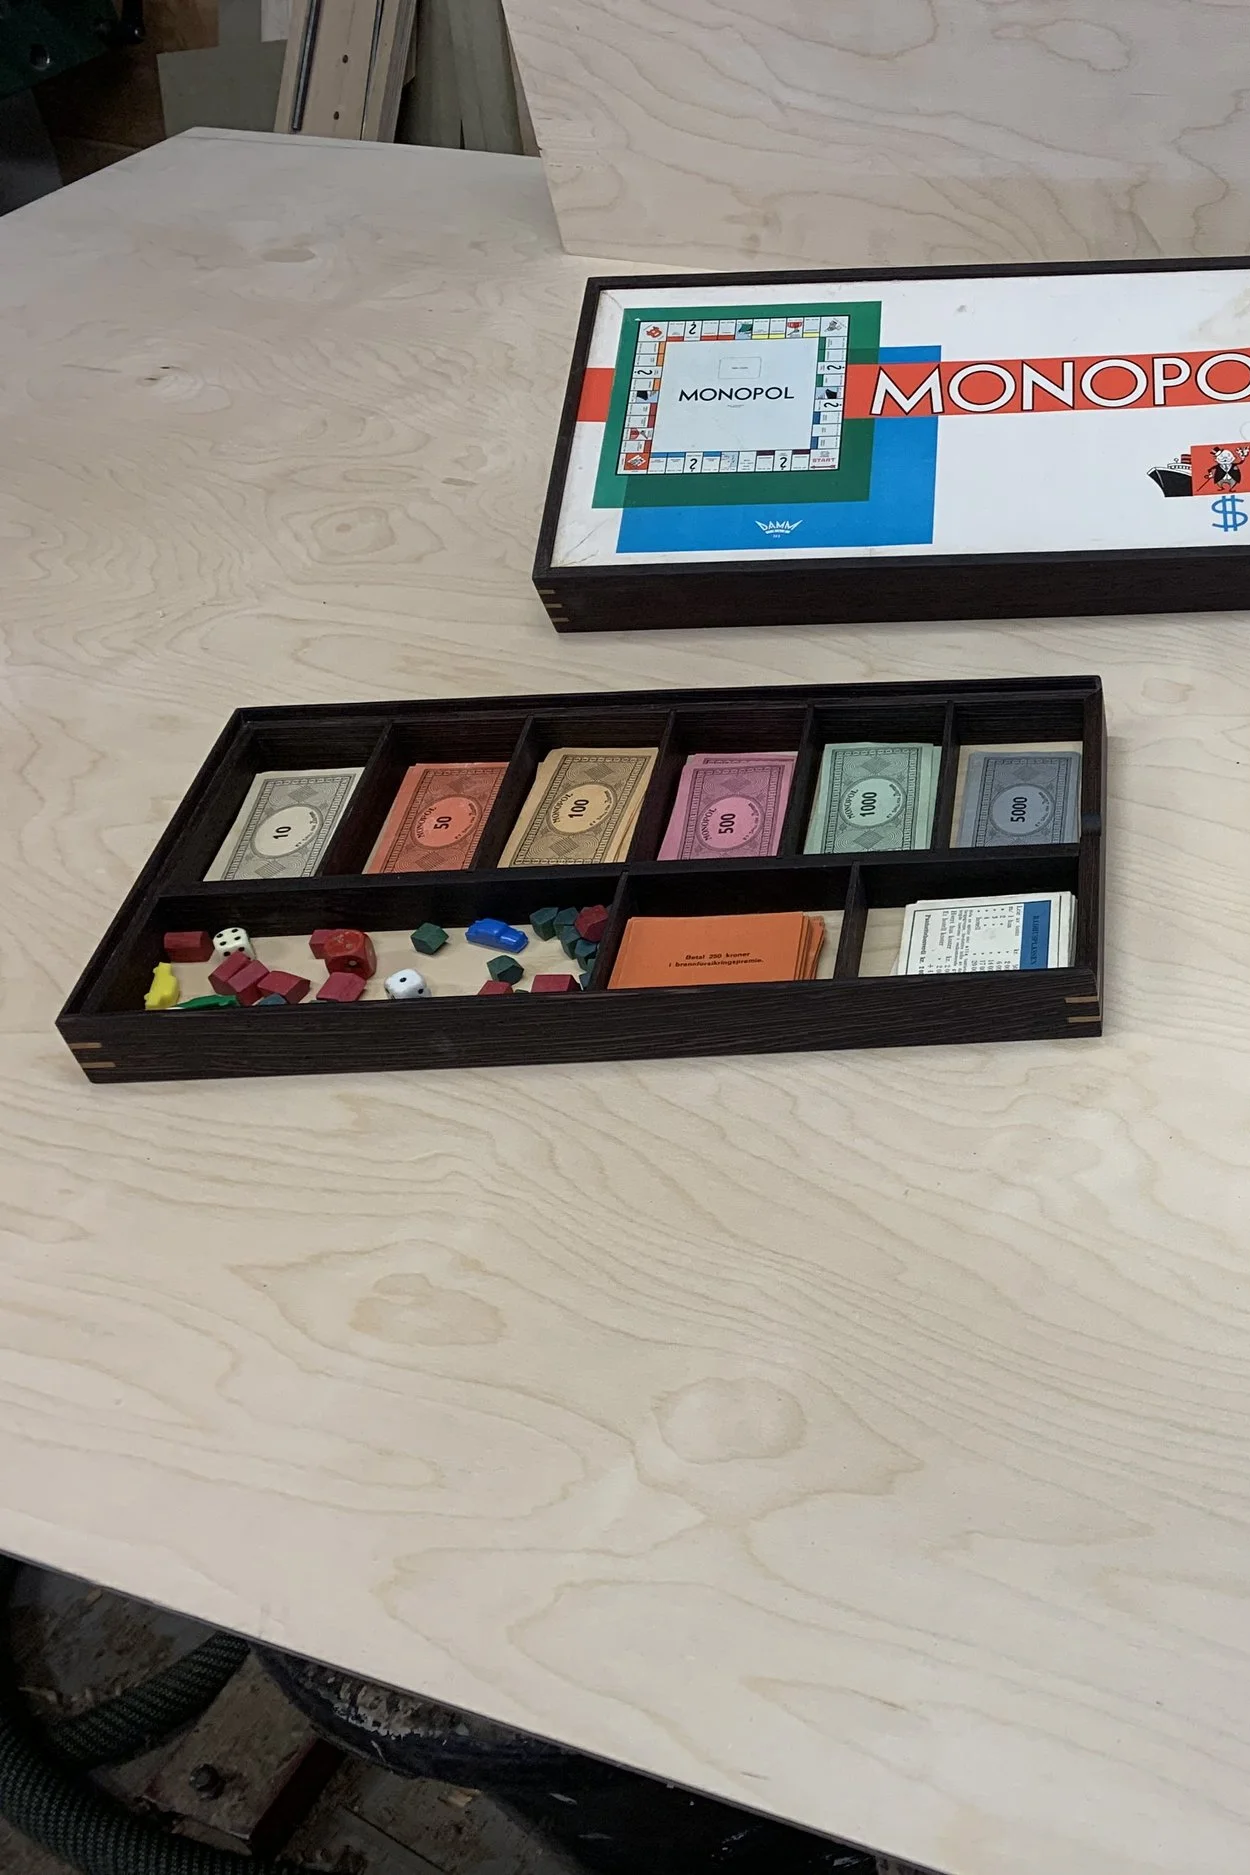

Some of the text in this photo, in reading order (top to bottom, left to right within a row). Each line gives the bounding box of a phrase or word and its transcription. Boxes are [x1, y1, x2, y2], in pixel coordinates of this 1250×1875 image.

[679, 386, 794, 402] MONOPOL
[549, 792, 574, 824] MONOPOL
[567, 799, 590, 819] 100
[848, 789, 859, 820] MONOPOL
[859, 791, 877, 817] 1000
[1010, 796, 1027, 822] 5000
[273, 826, 291, 840] 10
[416, 806, 438, 840] MONOPOL
[434, 816, 452, 830] 50
[703, 807, 717, 841] MONOPOL
[718, 813, 736, 834] 500
